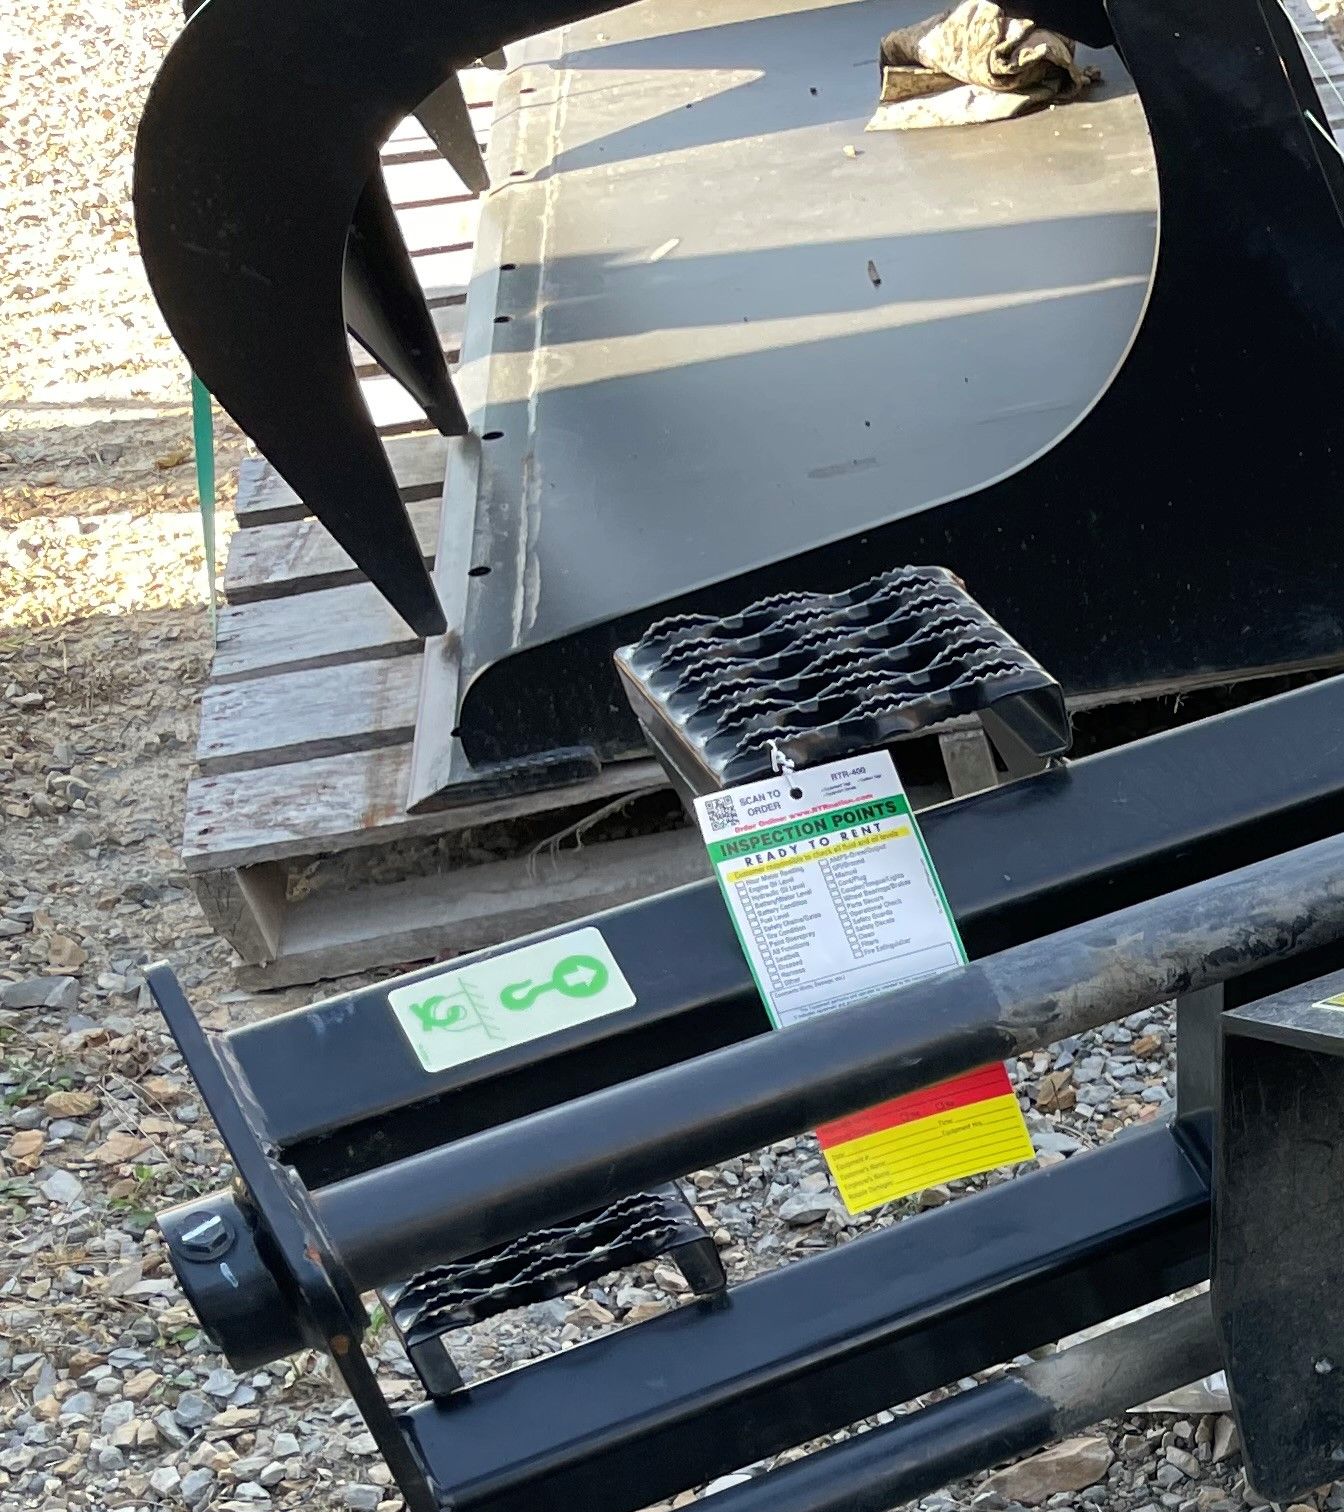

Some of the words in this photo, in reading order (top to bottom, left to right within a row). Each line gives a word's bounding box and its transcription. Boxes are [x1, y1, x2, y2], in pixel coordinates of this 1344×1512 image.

[831, 767, 866, 781] RTR-400
[739, 793, 765, 805] SCAN
[767, 789, 780, 798] TO
[747, 802, 780, 815] ORDER
[719, 818, 827, 856] INSPECTION
[831, 800, 897, 827] POINTS
[744, 845, 799, 865] READY
[809, 837, 829, 848] TO
[840, 823, 881, 840] RENT
